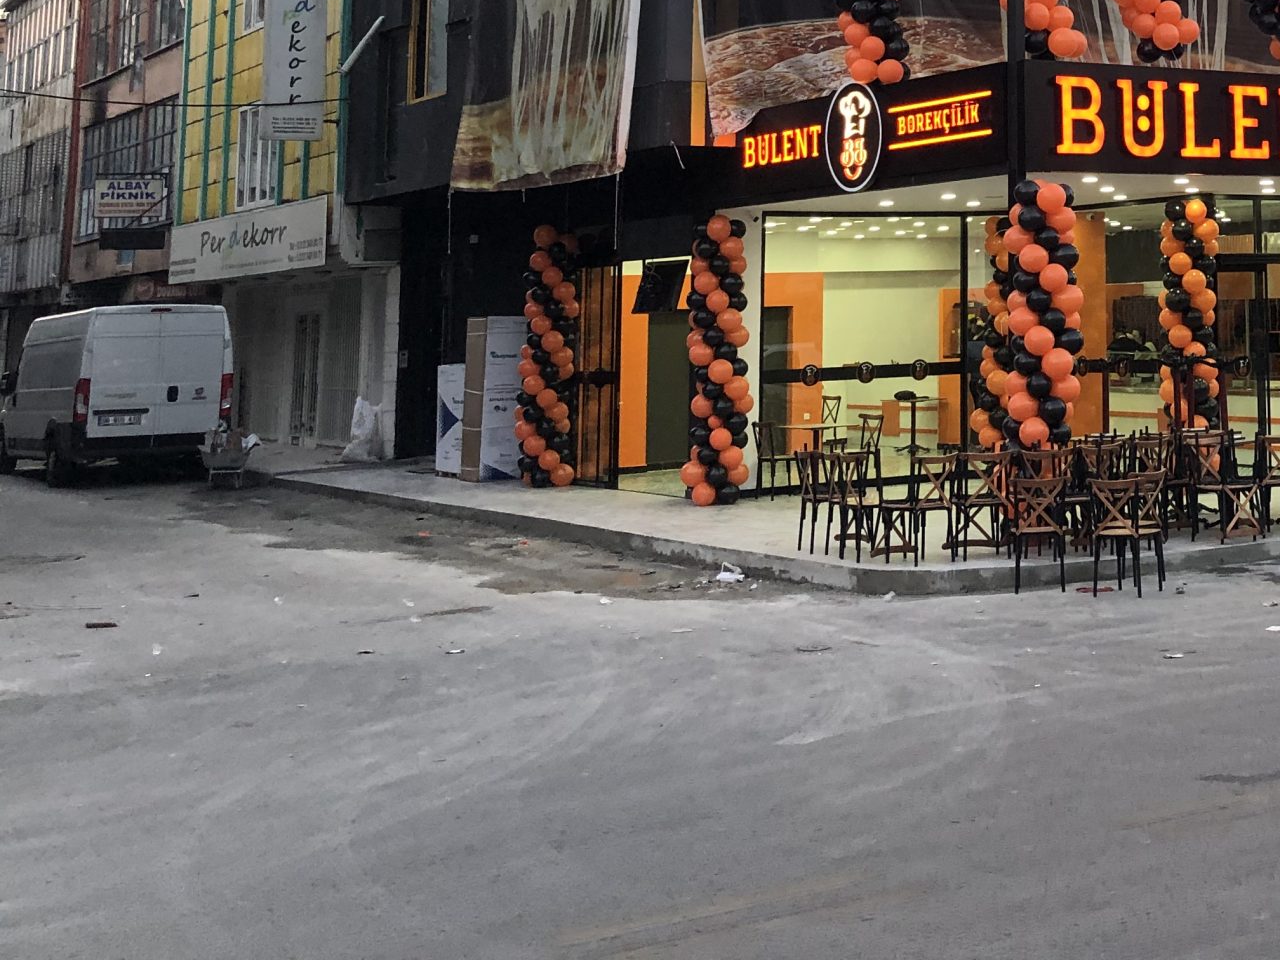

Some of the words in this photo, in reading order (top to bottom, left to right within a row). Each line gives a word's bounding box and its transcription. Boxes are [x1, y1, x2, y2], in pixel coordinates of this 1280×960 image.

[744, 125, 821, 168] BÜLENT
[107, 181, 150, 190] ALBAY
[100, 190, 156, 200] PİKNİK
